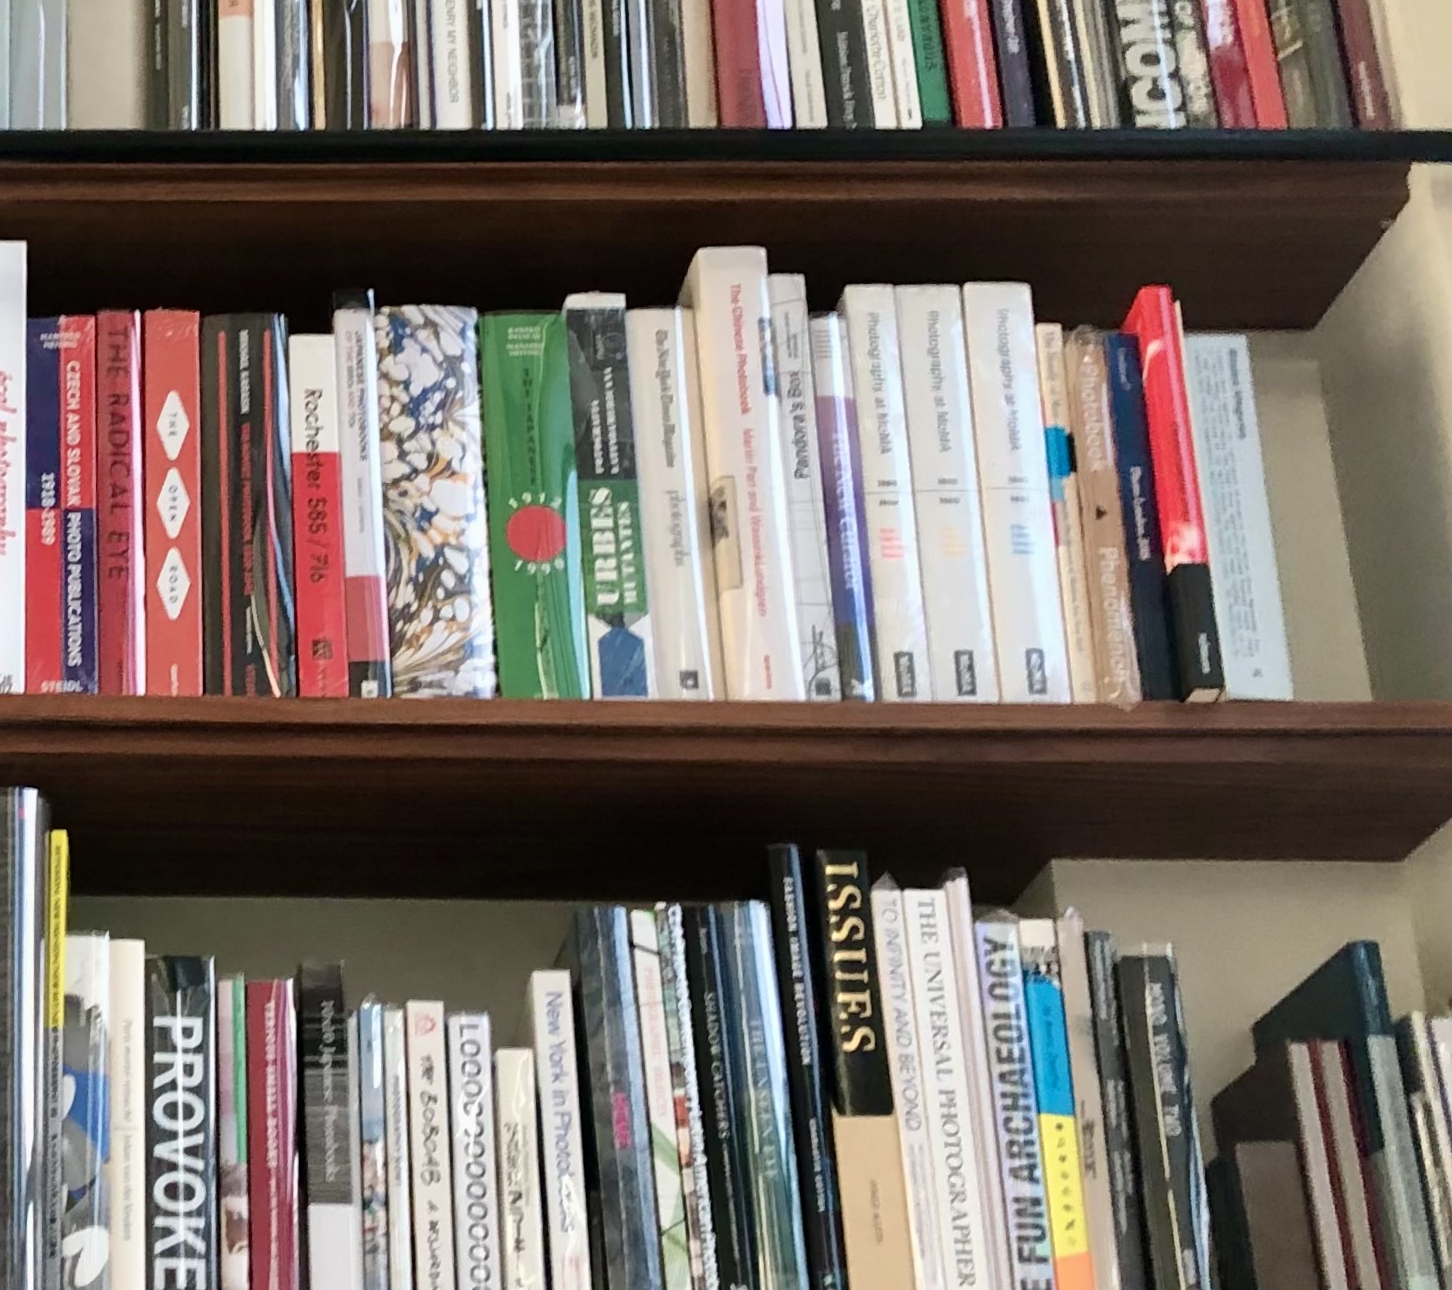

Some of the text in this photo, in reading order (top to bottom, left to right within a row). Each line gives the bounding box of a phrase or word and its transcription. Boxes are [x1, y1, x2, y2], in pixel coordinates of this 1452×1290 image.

[446, 30, 458, 46] MY
[446, 48, 461, 104] NEIGHBOR
[786, 370, 801, 399] Box
[866, 312, 892, 455] Photography at MoMA
[106, 325, 132, 581] THE RADICAL EYE
[166, 411, 178, 438] THE
[303, 389, 325, 491] Rochester
[788, 401, 810, 480] Pandora's
[65, 360, 83, 667] CZECH AND SLOVAK PHOTO PUBLICATIONS
[167, 485, 179, 523] OPEN
[308, 498, 327, 534] 585
[1079, 364, 1128, 683] Photobook Phenomenon
[167, 564, 180, 605] ROAD
[309, 552, 328, 584] 716
[588, 487, 621, 606] URBES
[823, 861, 876, 1054] ISSUES
[917, 897, 978, 1289] THE UNIVERSAL PHOTOGRAPHER
[983, 936, 1042, 1186] ARCHAEOLOGY
[1013, 1196, 1051, 1265] FUN
